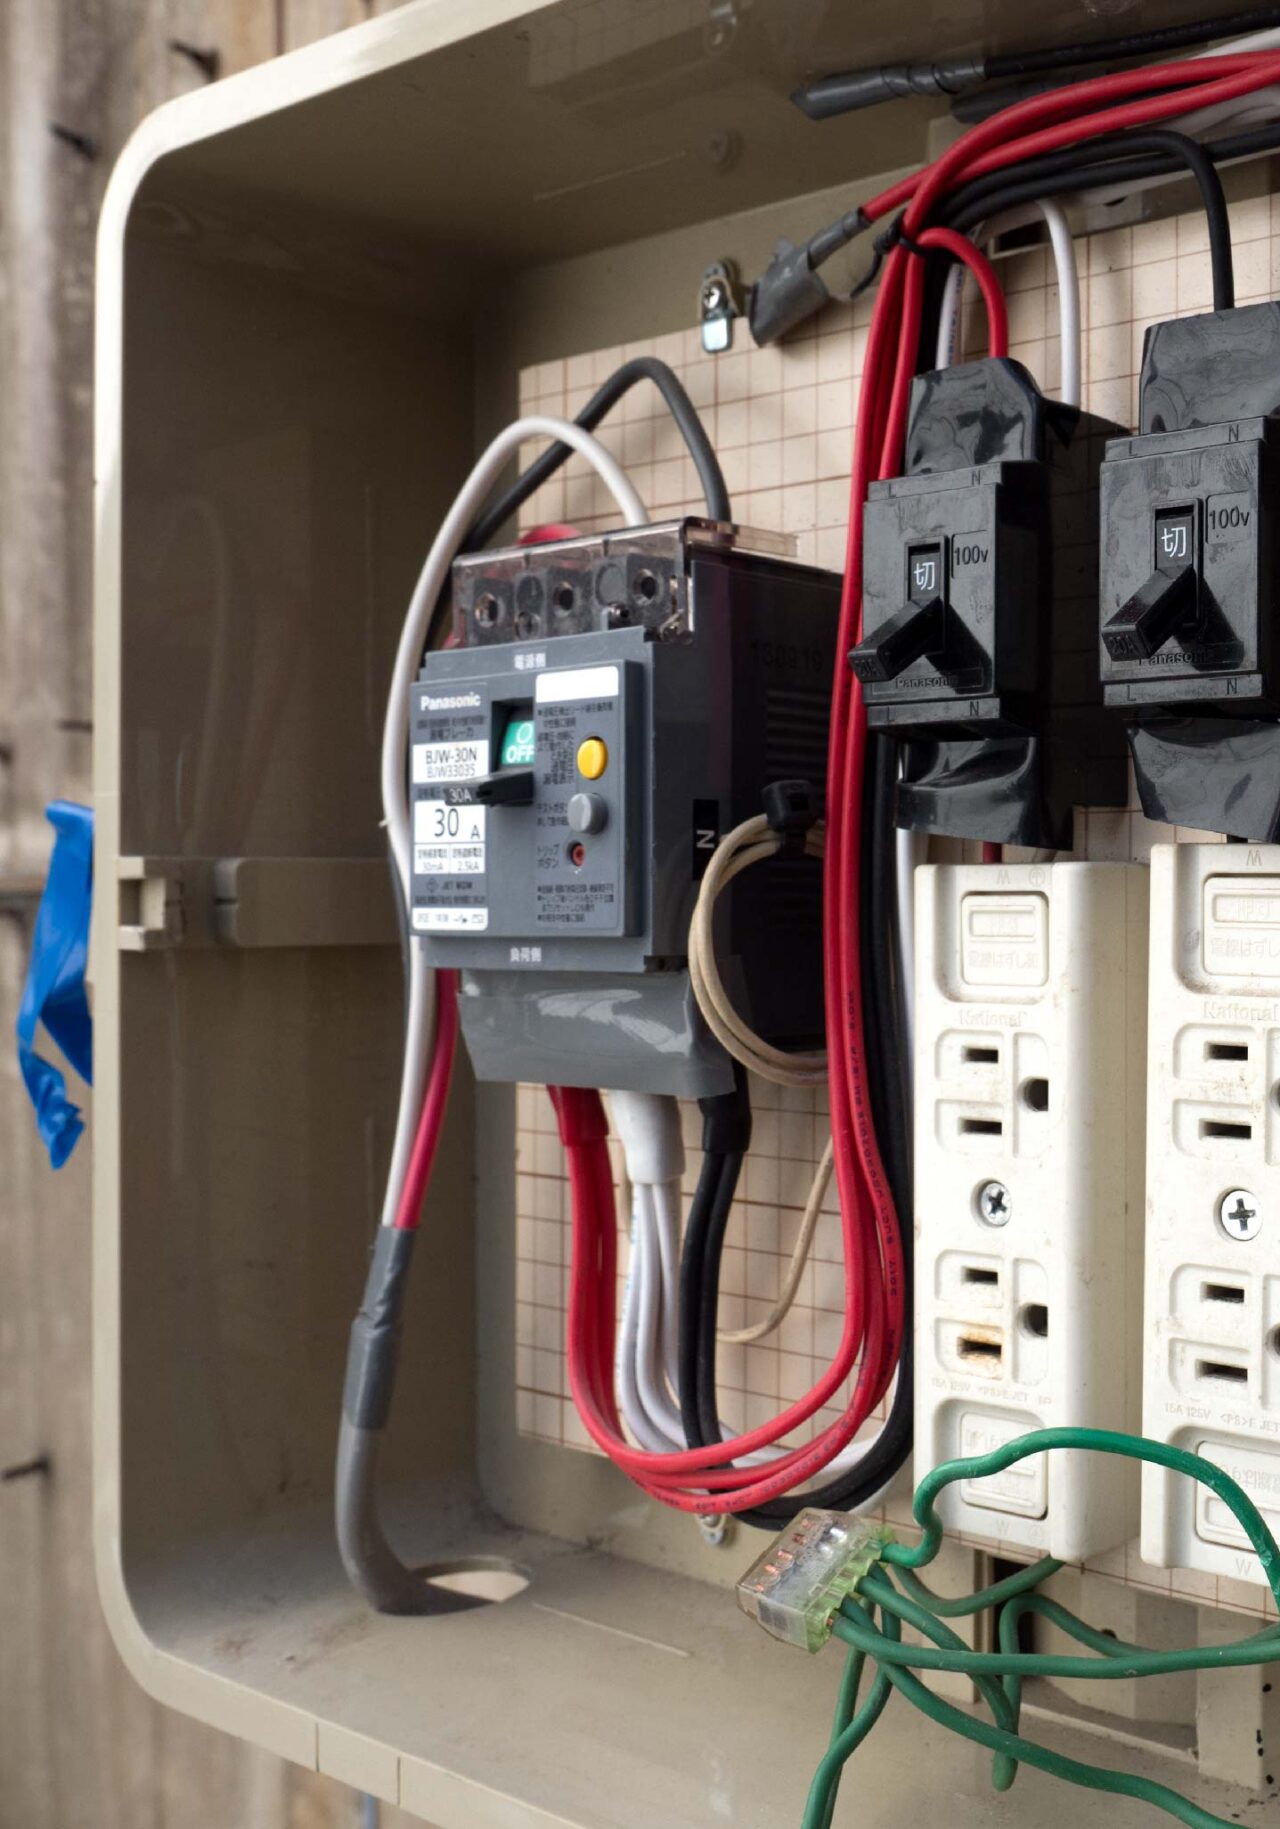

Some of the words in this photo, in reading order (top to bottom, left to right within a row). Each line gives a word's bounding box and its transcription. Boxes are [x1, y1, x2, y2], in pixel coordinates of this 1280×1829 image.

[1228, 423, 1240, 442] N
[971, 471, 982, 486] N
[1161, 526, 1187, 558] 切
[913, 561, 936, 591] 切
[1226, 678, 1238, 696] N
[420, 691, 481, 711] Panasonic
[969, 702, 980, 717] N
[425, 747, 477, 765] BJW-30N
[505, 744, 535, 764] OFF
[448, 787, 473, 803] 30A
[433, 808, 460, 838] 30
[470, 824, 481, 841] A
[1203, 1001, 1279, 1022] National
